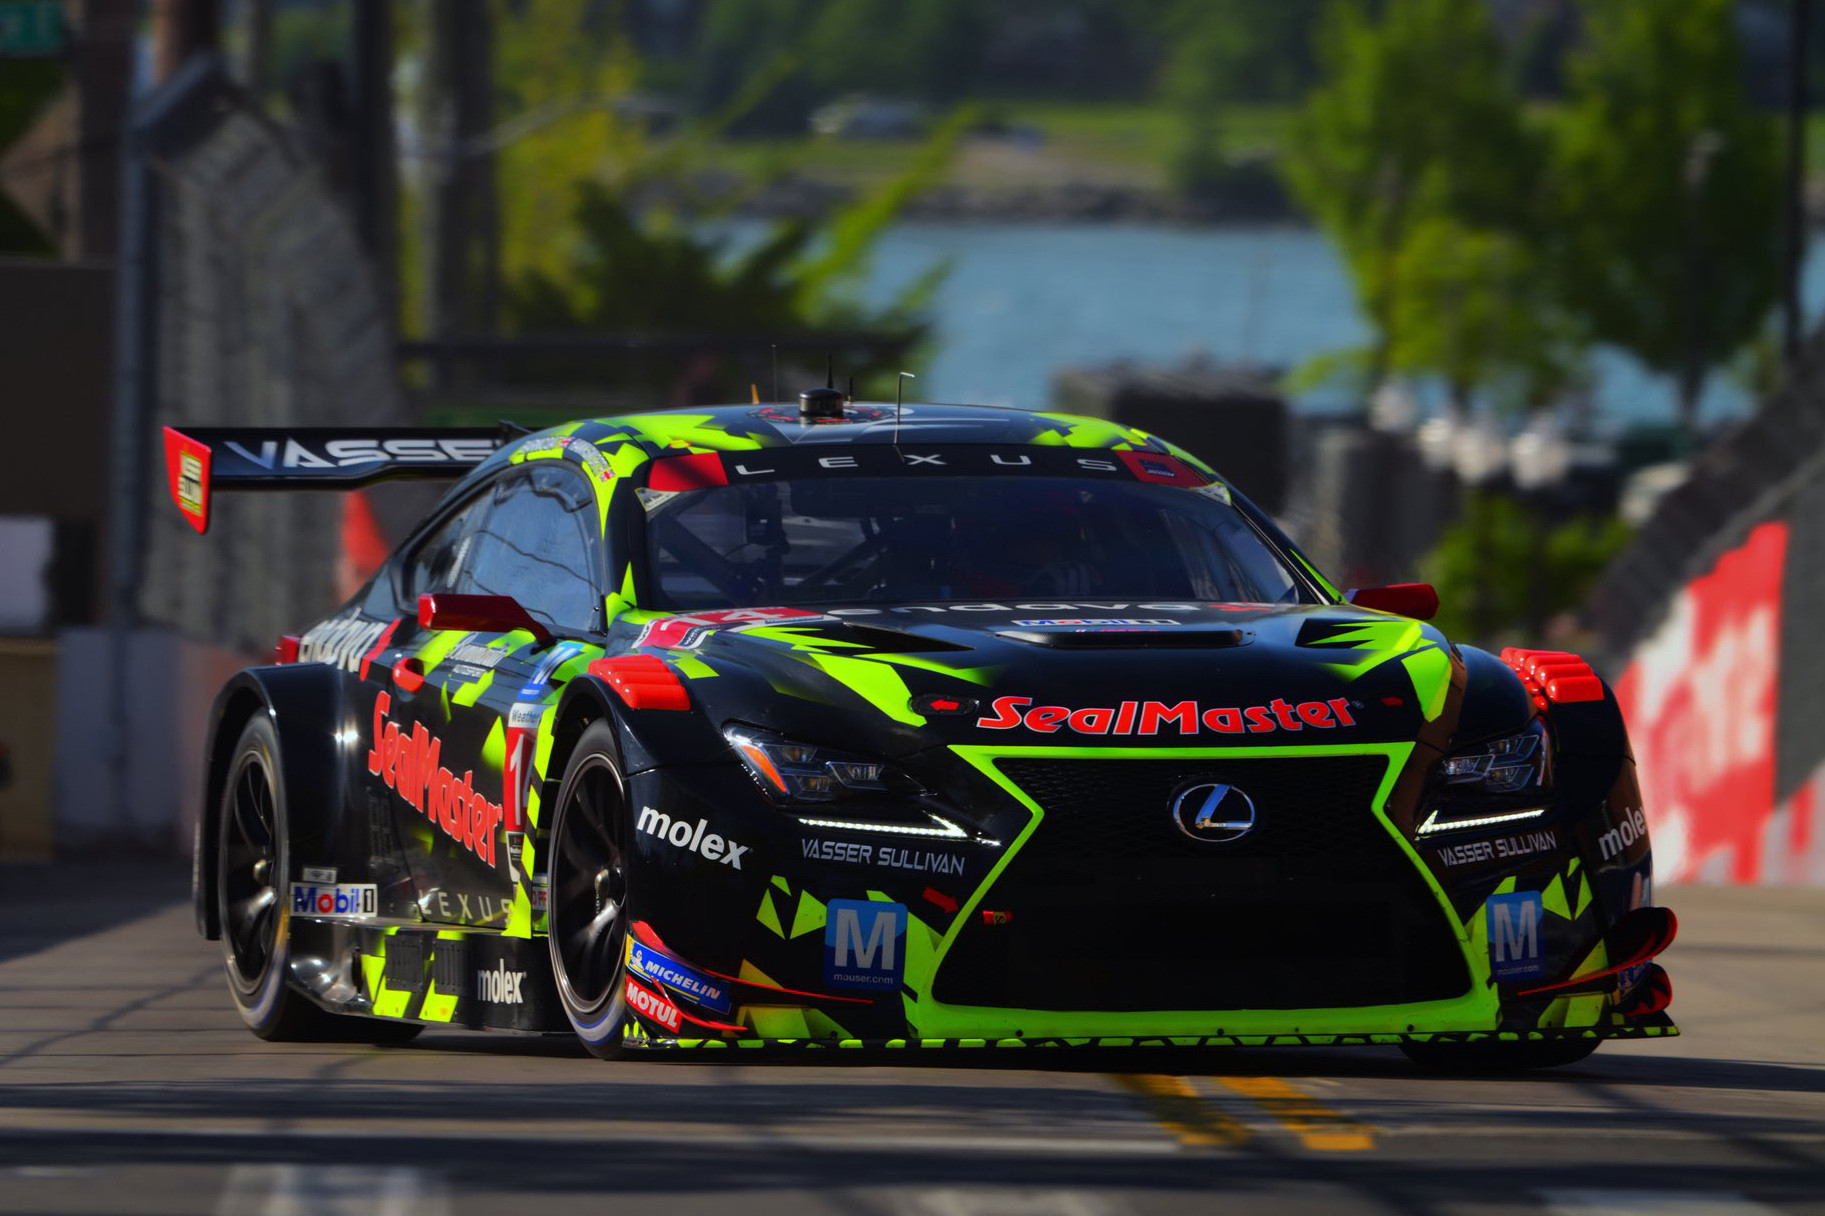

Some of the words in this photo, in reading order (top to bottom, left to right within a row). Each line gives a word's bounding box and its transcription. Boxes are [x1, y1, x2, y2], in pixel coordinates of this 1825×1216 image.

[223, 437, 503, 470] VASSE
[735, 453, 1118, 476] LEXUS
[976, 695, 1357, 735] SealMaster
[368, 690, 497, 869] SealMaster
[637, 805, 750, 871] molex
[1437, 841, 1495, 868] VASSER
[1495, 830, 1558, 858] SULLIVAN
[1598, 806, 1646, 861] mole
[801, 838, 873, 864] VASSER
[877, 847, 966, 877] SULLIVAN
[294, 886, 359, 914] Mobil
[363, 888, 374, 913] 1
[834, 908, 897, 971] M
[1493, 899, 1538, 962] M
[477, 958, 524, 1004] molex
[645, 960, 722, 1000] MICHELIN
[833, 973, 893, 985] mouser.com
[626, 981, 679, 1028] MOTUL
